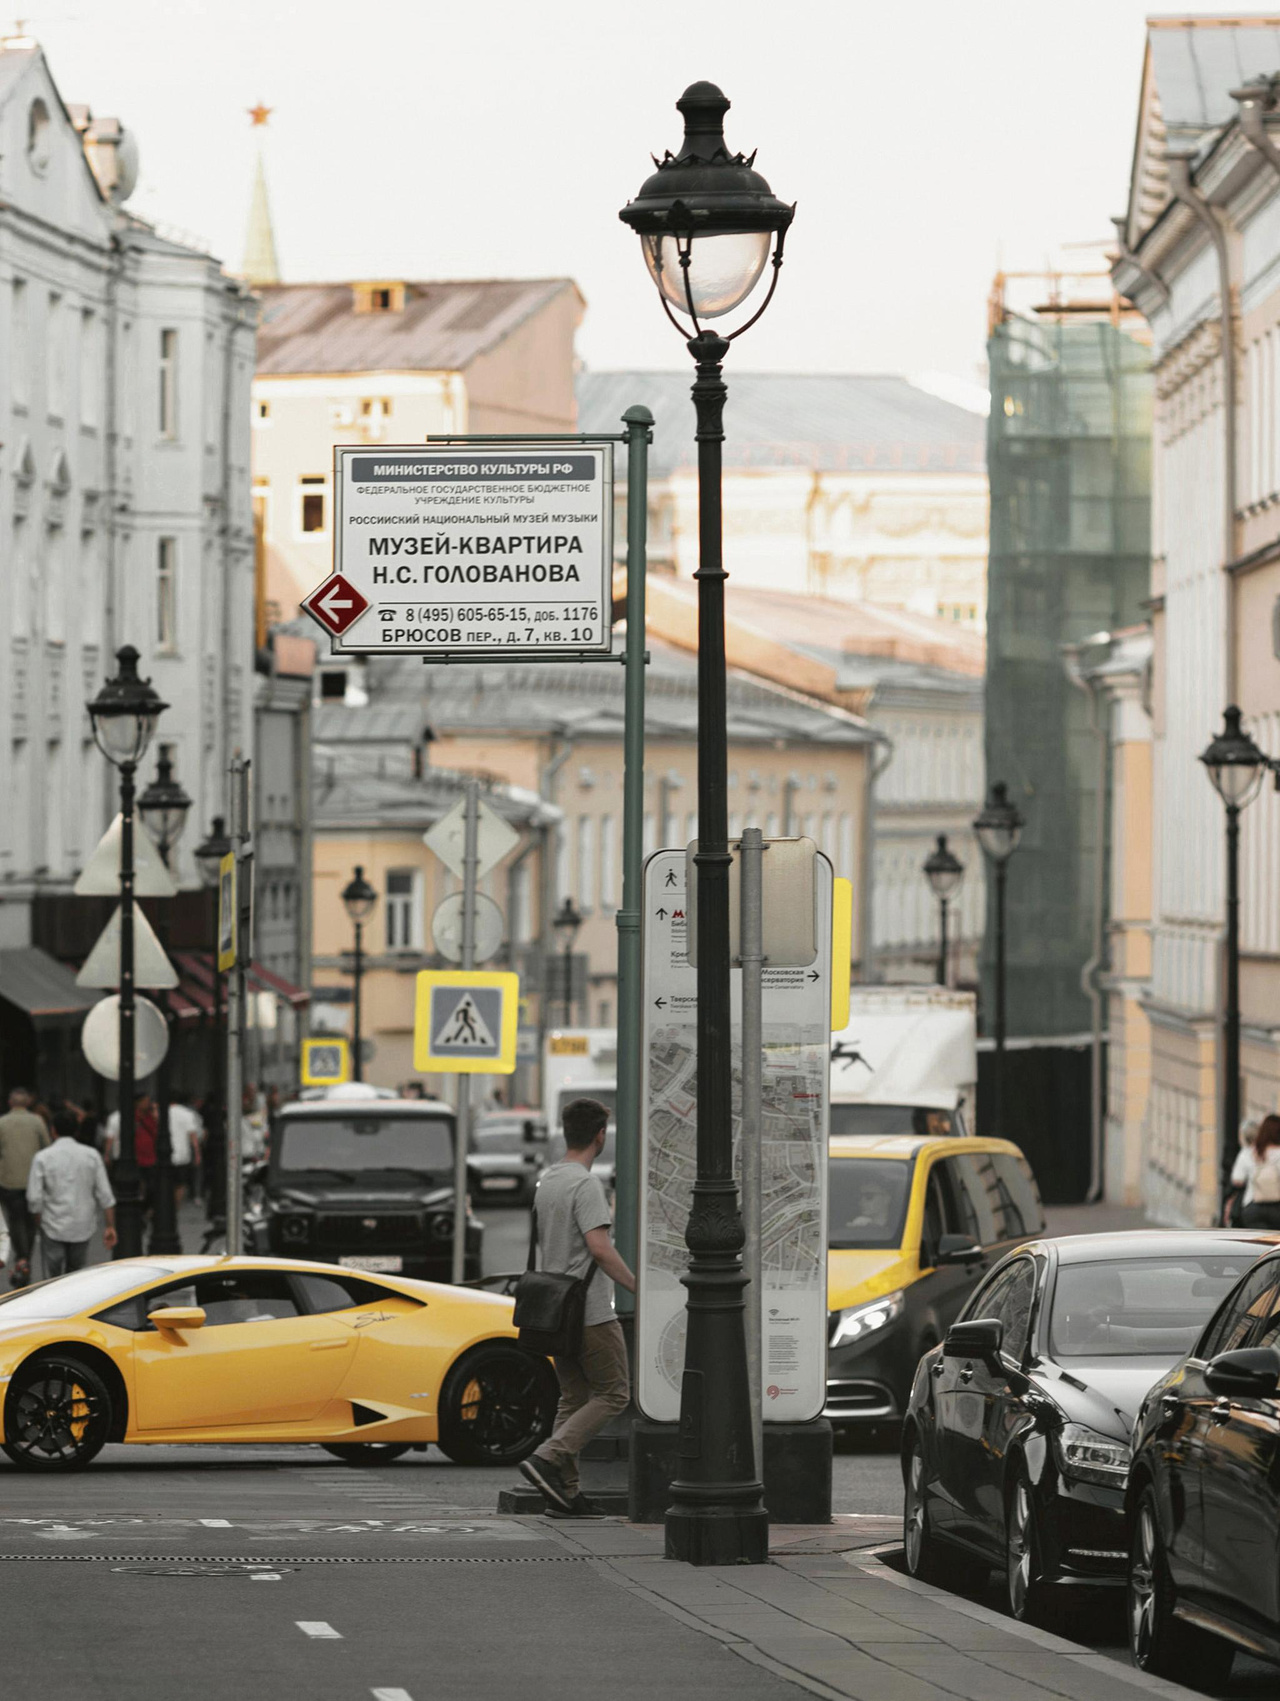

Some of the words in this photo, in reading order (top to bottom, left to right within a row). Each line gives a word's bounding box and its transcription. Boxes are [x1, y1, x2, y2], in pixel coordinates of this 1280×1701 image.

[373, 463, 478, 477] МИНИСТЕРСТВО
[480, 462, 550, 476] КУЛЬТУРЫ
[552, 462, 573, 475] РФ
[356, 484, 429, 496] ФЕДЕРАЛЬНОЕ
[430, 484, 525, 495] ГОСУДАРСТВЕННОЕ
[527, 483, 591, 495] БЮДЖЕТНОЕ
[414, 495, 481, 506] УЧРЕЖДЕНИЕ
[483, 495, 535, 505] КУЛЬТУРЫ
[422, 513, 510, 525] НАЦИОНАЛЬНЫЙ
[513, 513, 549, 524] МУЗЕЙ
[551, 513, 598, 524] МУЗЫКИ
[369, 532, 584, 556] МУЗЕЙ-КВАРТИРА
[372, 565, 418, 584] Н.С.
[423, 564, 581, 584] ГОЛОВАНОВА
[405, 608, 415, 622] 8
[417, 607, 454, 624] (495)
[456, 607, 531, 623] 605-65-15,
[563, 607, 598, 621] 1176
[382, 628, 462, 643] БРЮСОВ
[524, 628, 540, 644] 7,
[570, 627, 593, 641] 10
